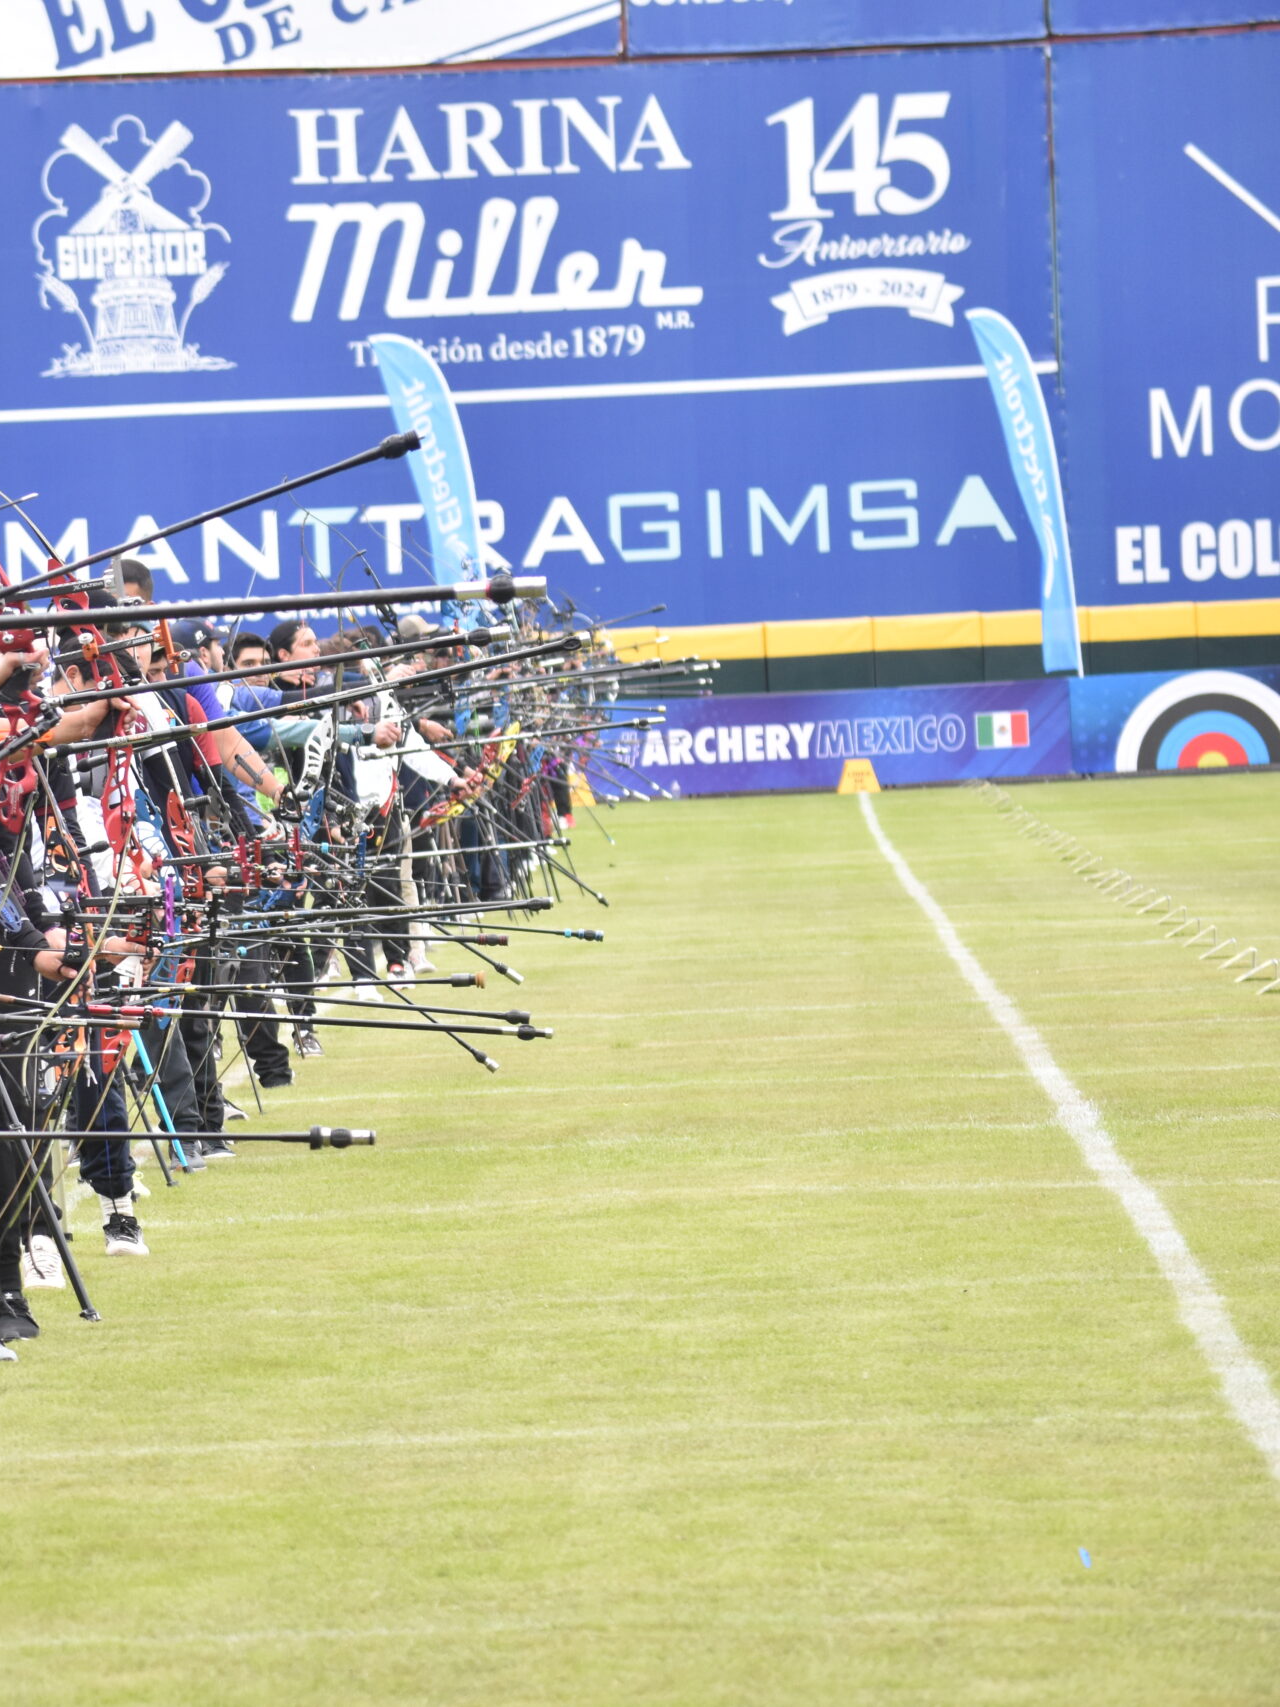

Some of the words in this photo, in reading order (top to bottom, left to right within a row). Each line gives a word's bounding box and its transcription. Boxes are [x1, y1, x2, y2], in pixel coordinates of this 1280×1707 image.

[215, 5, 302, 65] DE
[288, 94, 693, 185] HARINA
[766, 91, 951, 221] 145
[57, 231, 208, 281] SUPERIOR
[286, 196, 704, 322] Miller
[758, 219, 971, 269] Aniversario
[810, 282, 858, 305] 1879
[878, 279, 928, 299] 2024
[490, 333, 569, 361] desde
[570, 324, 646, 358] 1879
[656, 311, 695, 330] M.R.
[1116, 525, 1170, 584] EL
